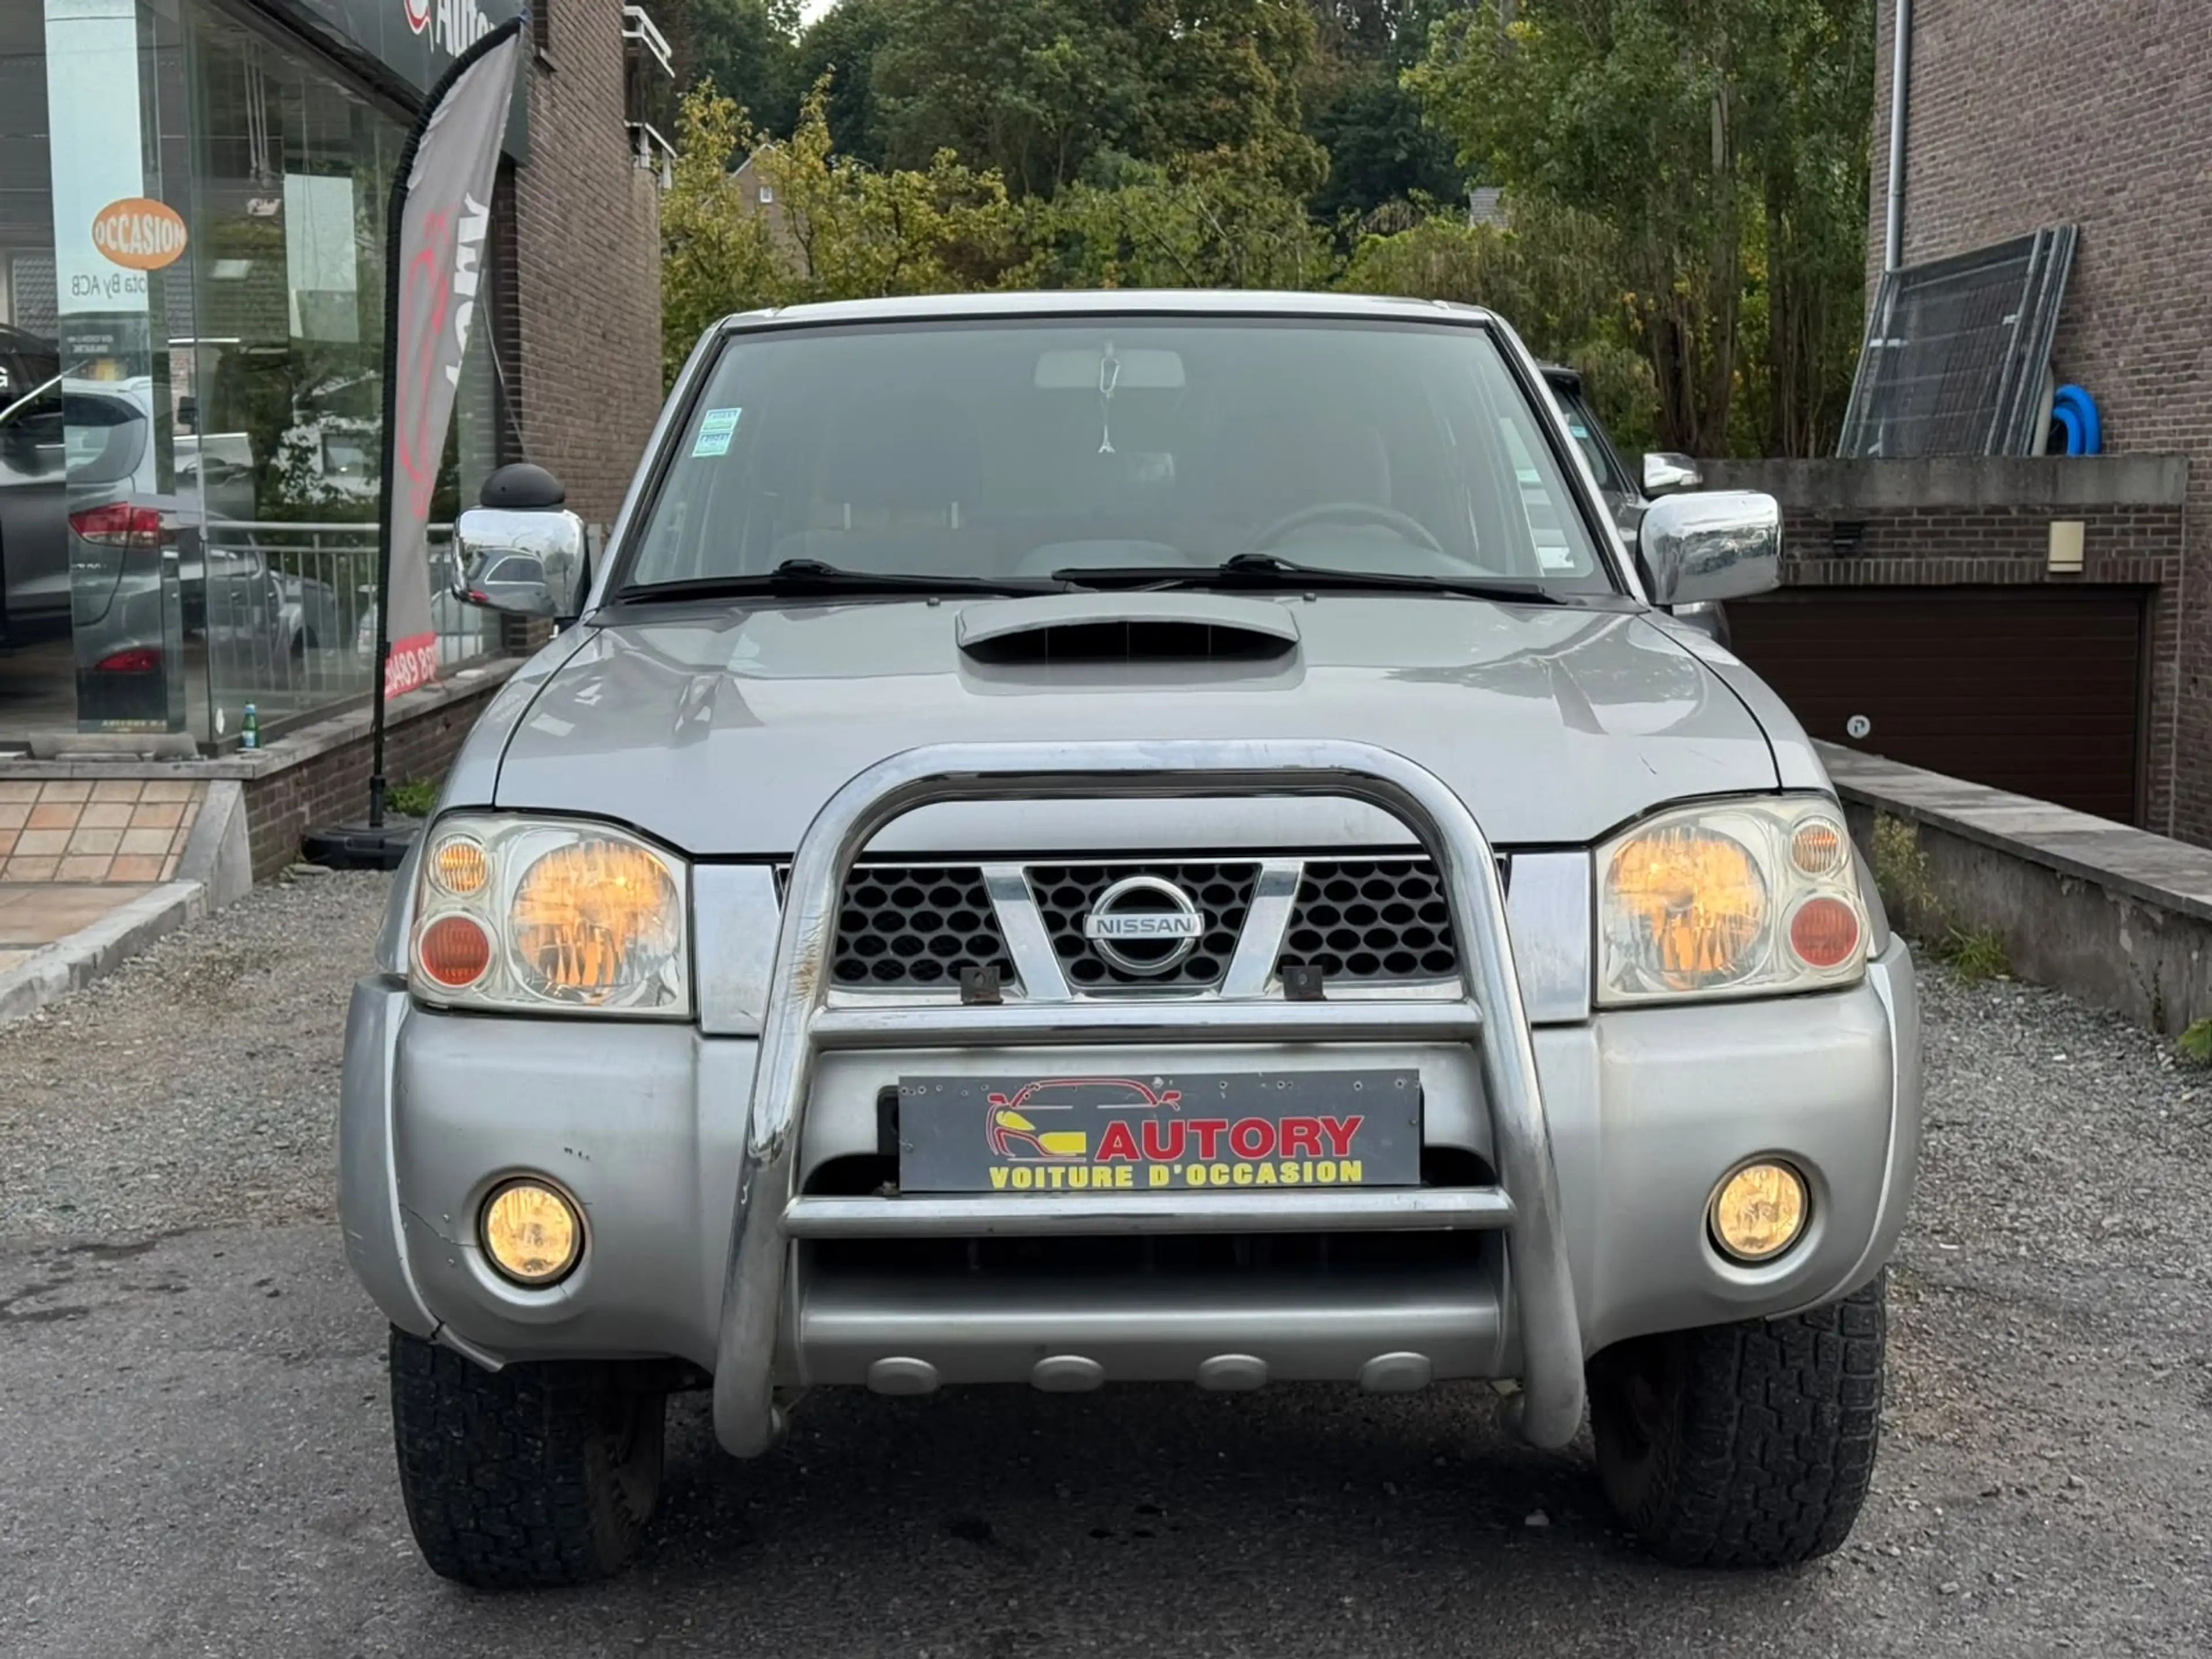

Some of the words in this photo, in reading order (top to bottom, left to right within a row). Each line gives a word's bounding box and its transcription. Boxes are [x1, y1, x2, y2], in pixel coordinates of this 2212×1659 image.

[94, 213, 185, 255] OCCASION
[1096, 918, 1191, 934] NISSAN
[1096, 1116, 1363, 1161] AUTORY
[989, 1165, 1134, 1189] VOITURE
[1150, 1161, 1361, 1187] D'OCCASION
